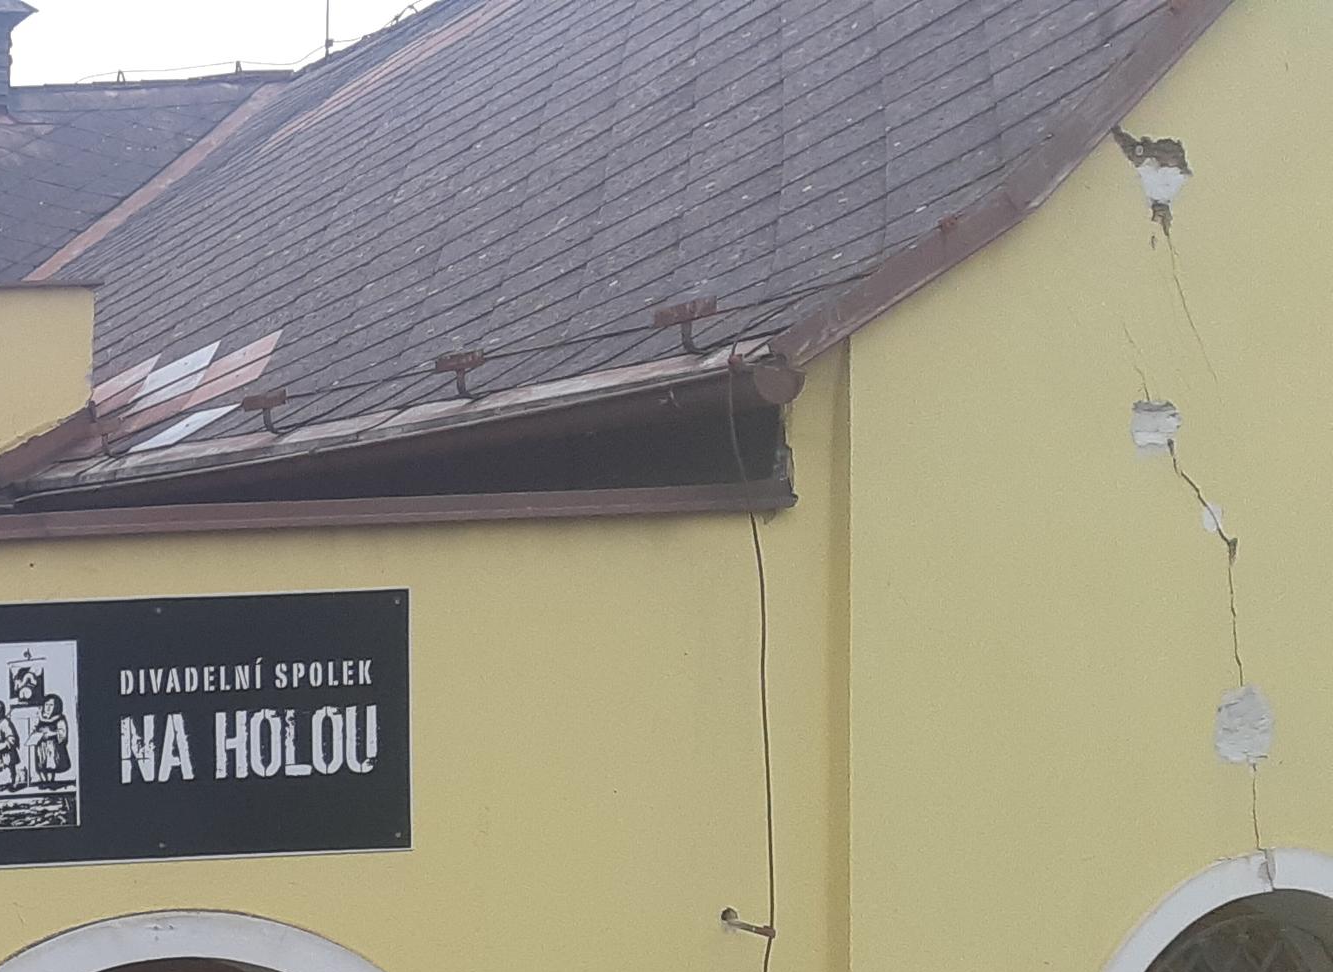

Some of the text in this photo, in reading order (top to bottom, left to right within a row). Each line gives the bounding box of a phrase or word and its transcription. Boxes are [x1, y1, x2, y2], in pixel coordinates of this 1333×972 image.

[120, 657, 373, 695] DIVADELNÍ SPOLEK
[120, 705, 379, 784] NA HOLOU
